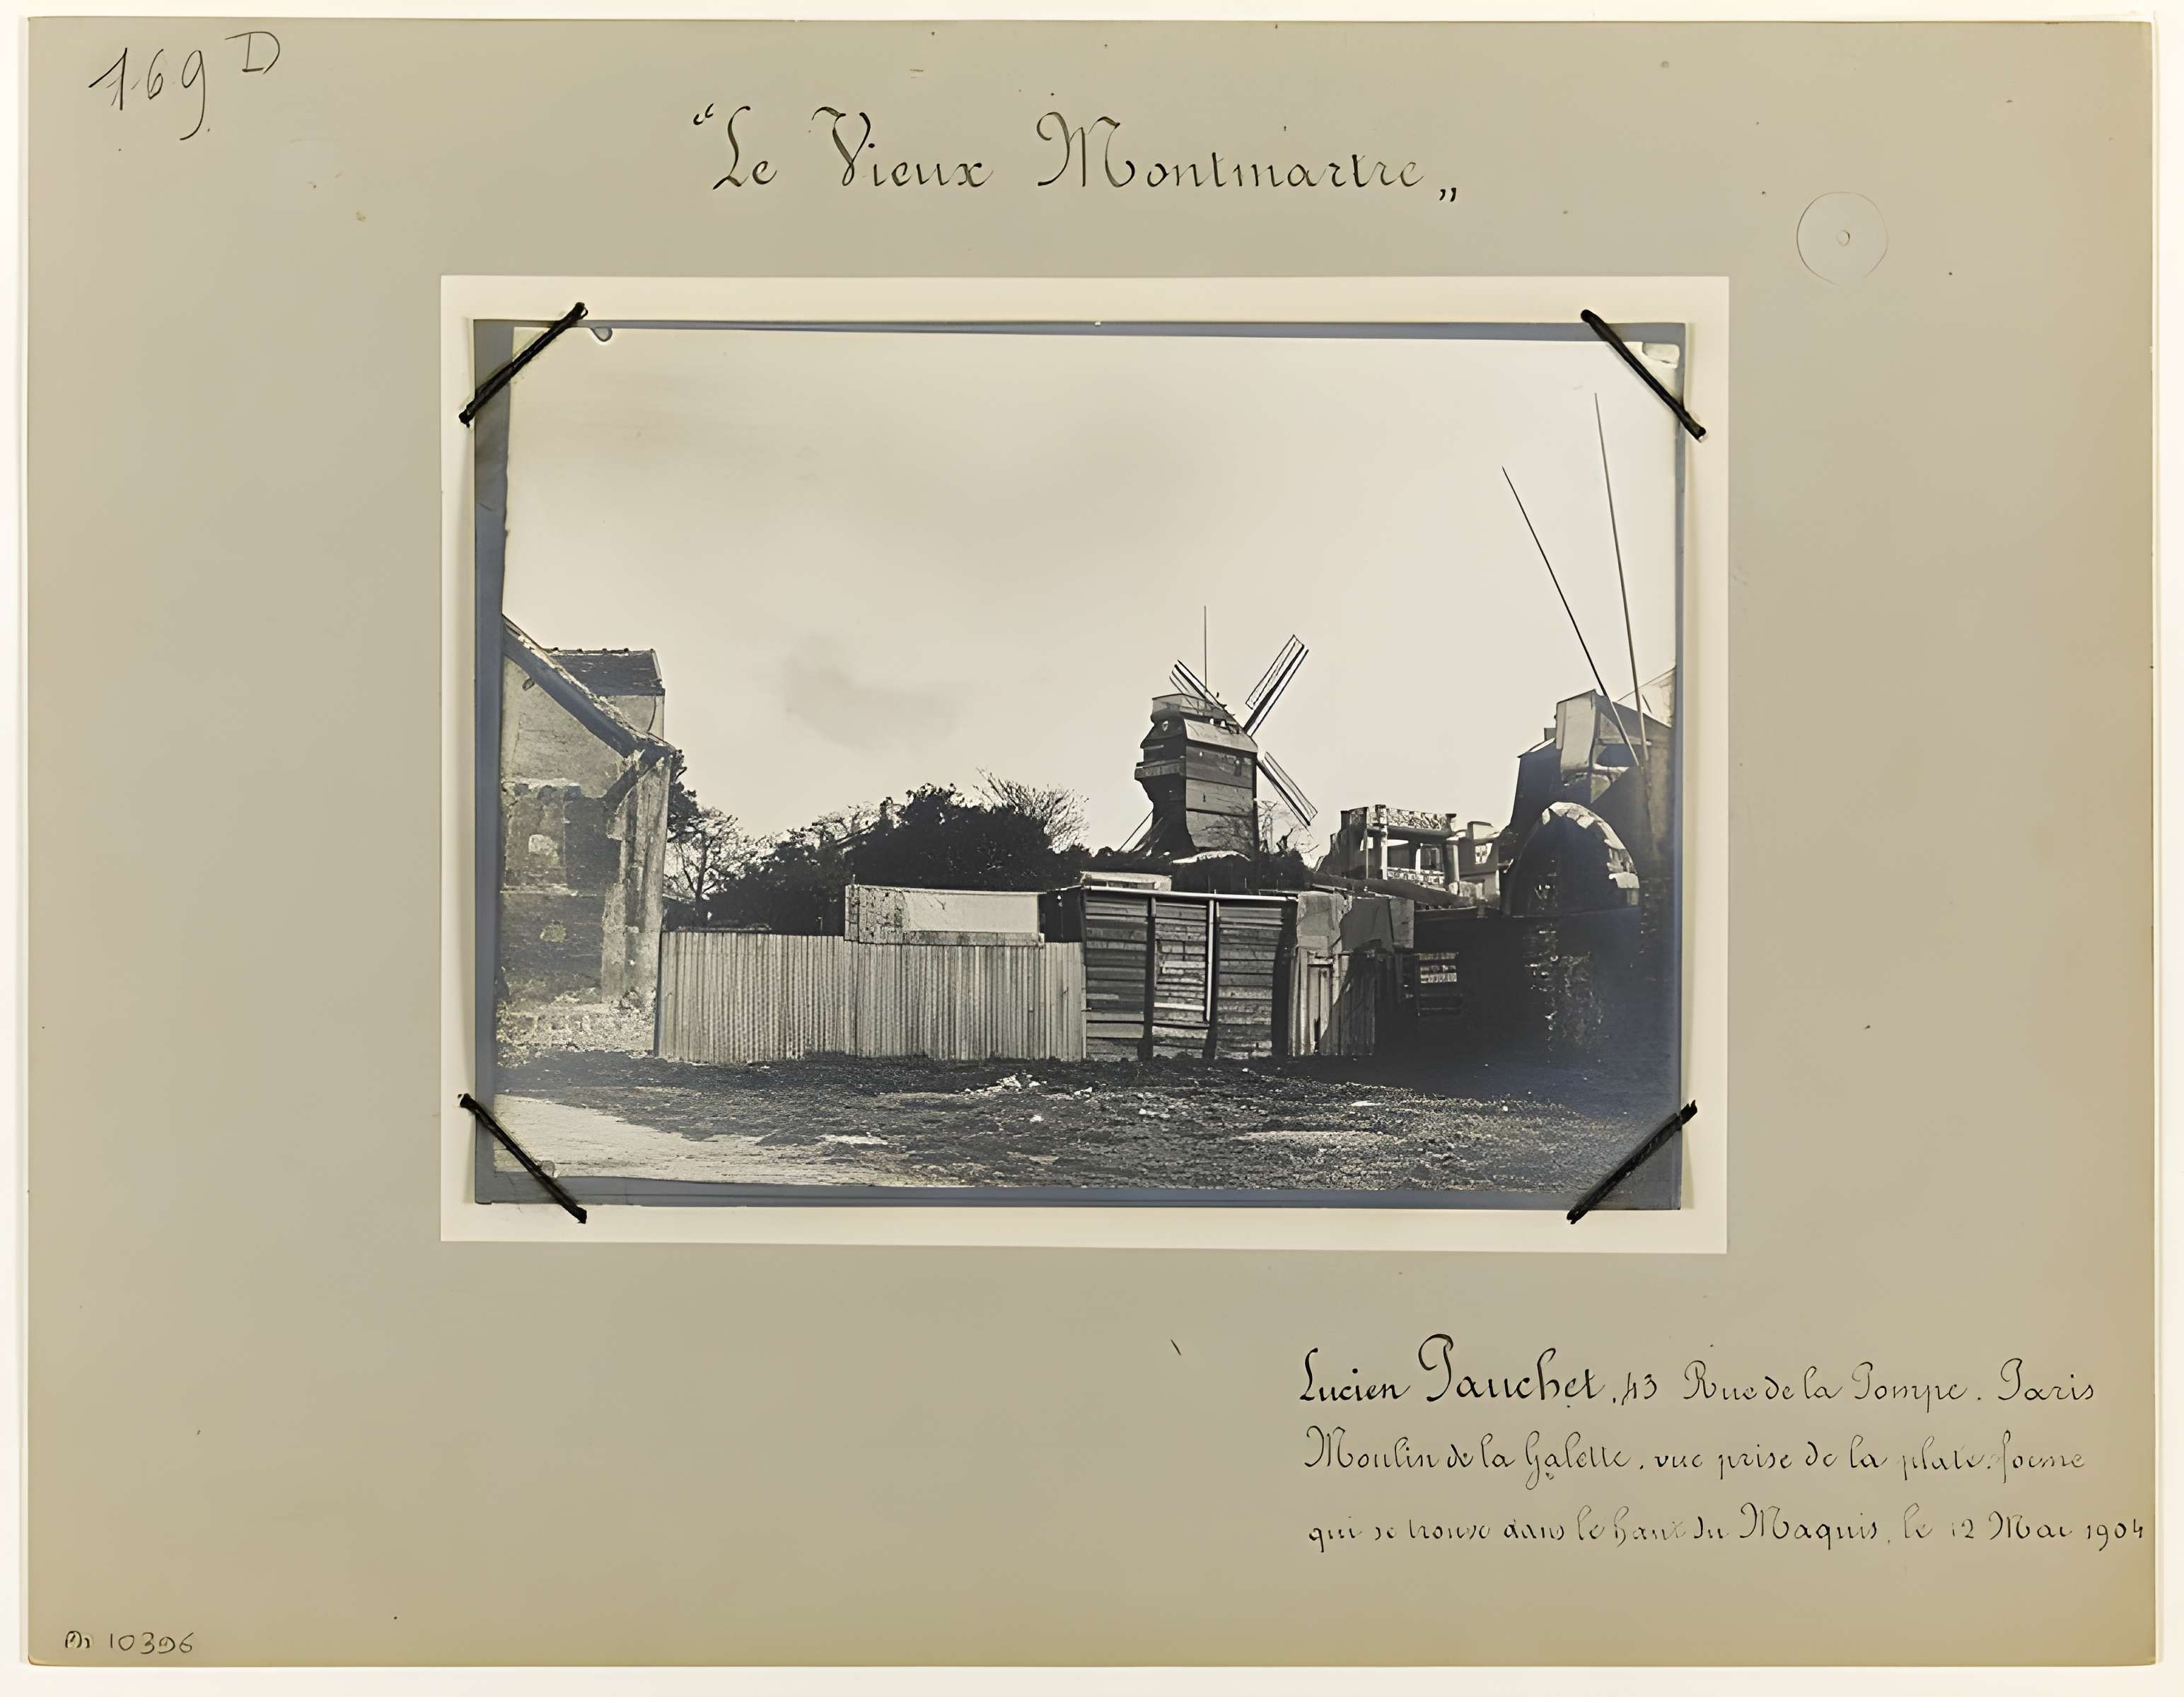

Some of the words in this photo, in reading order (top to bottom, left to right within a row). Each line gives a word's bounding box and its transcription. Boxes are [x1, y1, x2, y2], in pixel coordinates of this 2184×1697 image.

[223, 30, 281, 75] D
[811, 105, 995, 189] Vieux
[1299, 1347, 1412, 1402] Lucien
[1683, 1360, 1758, 1401] Rue
[1764, 1372, 1795, 1400] de
[1803, 1365, 1844, 1400] la
[1997, 1357, 2095, 1401] Paris
[1303, 1425, 1441, 1469] Moulin
[1446, 1443, 1475, 1469] de
[1480, 1432, 1516, 1469] la
[1654, 1453, 1704, 1469] vue
[1717, 1443, 1794, 1481] prise
[1805, 1440, 1839, 1469] de
[1849, 1434, 1889, 1469] la
[1308, 1515, 1363, 1553] qui
[1408, 1518, 1492, 1541] trouve
[1503, 1518, 1566, 1541] dans
[1576, 1505, 1606, 1541] le
[1613, 1505, 1688, 1549] haut
[1903, 1502, 1934, 1540] le
[1951, 1518, 1975, 1540] 12
[1988, 1510, 2074, 1541] Mai
[2086, 1518, 2144, 1552] 1904
